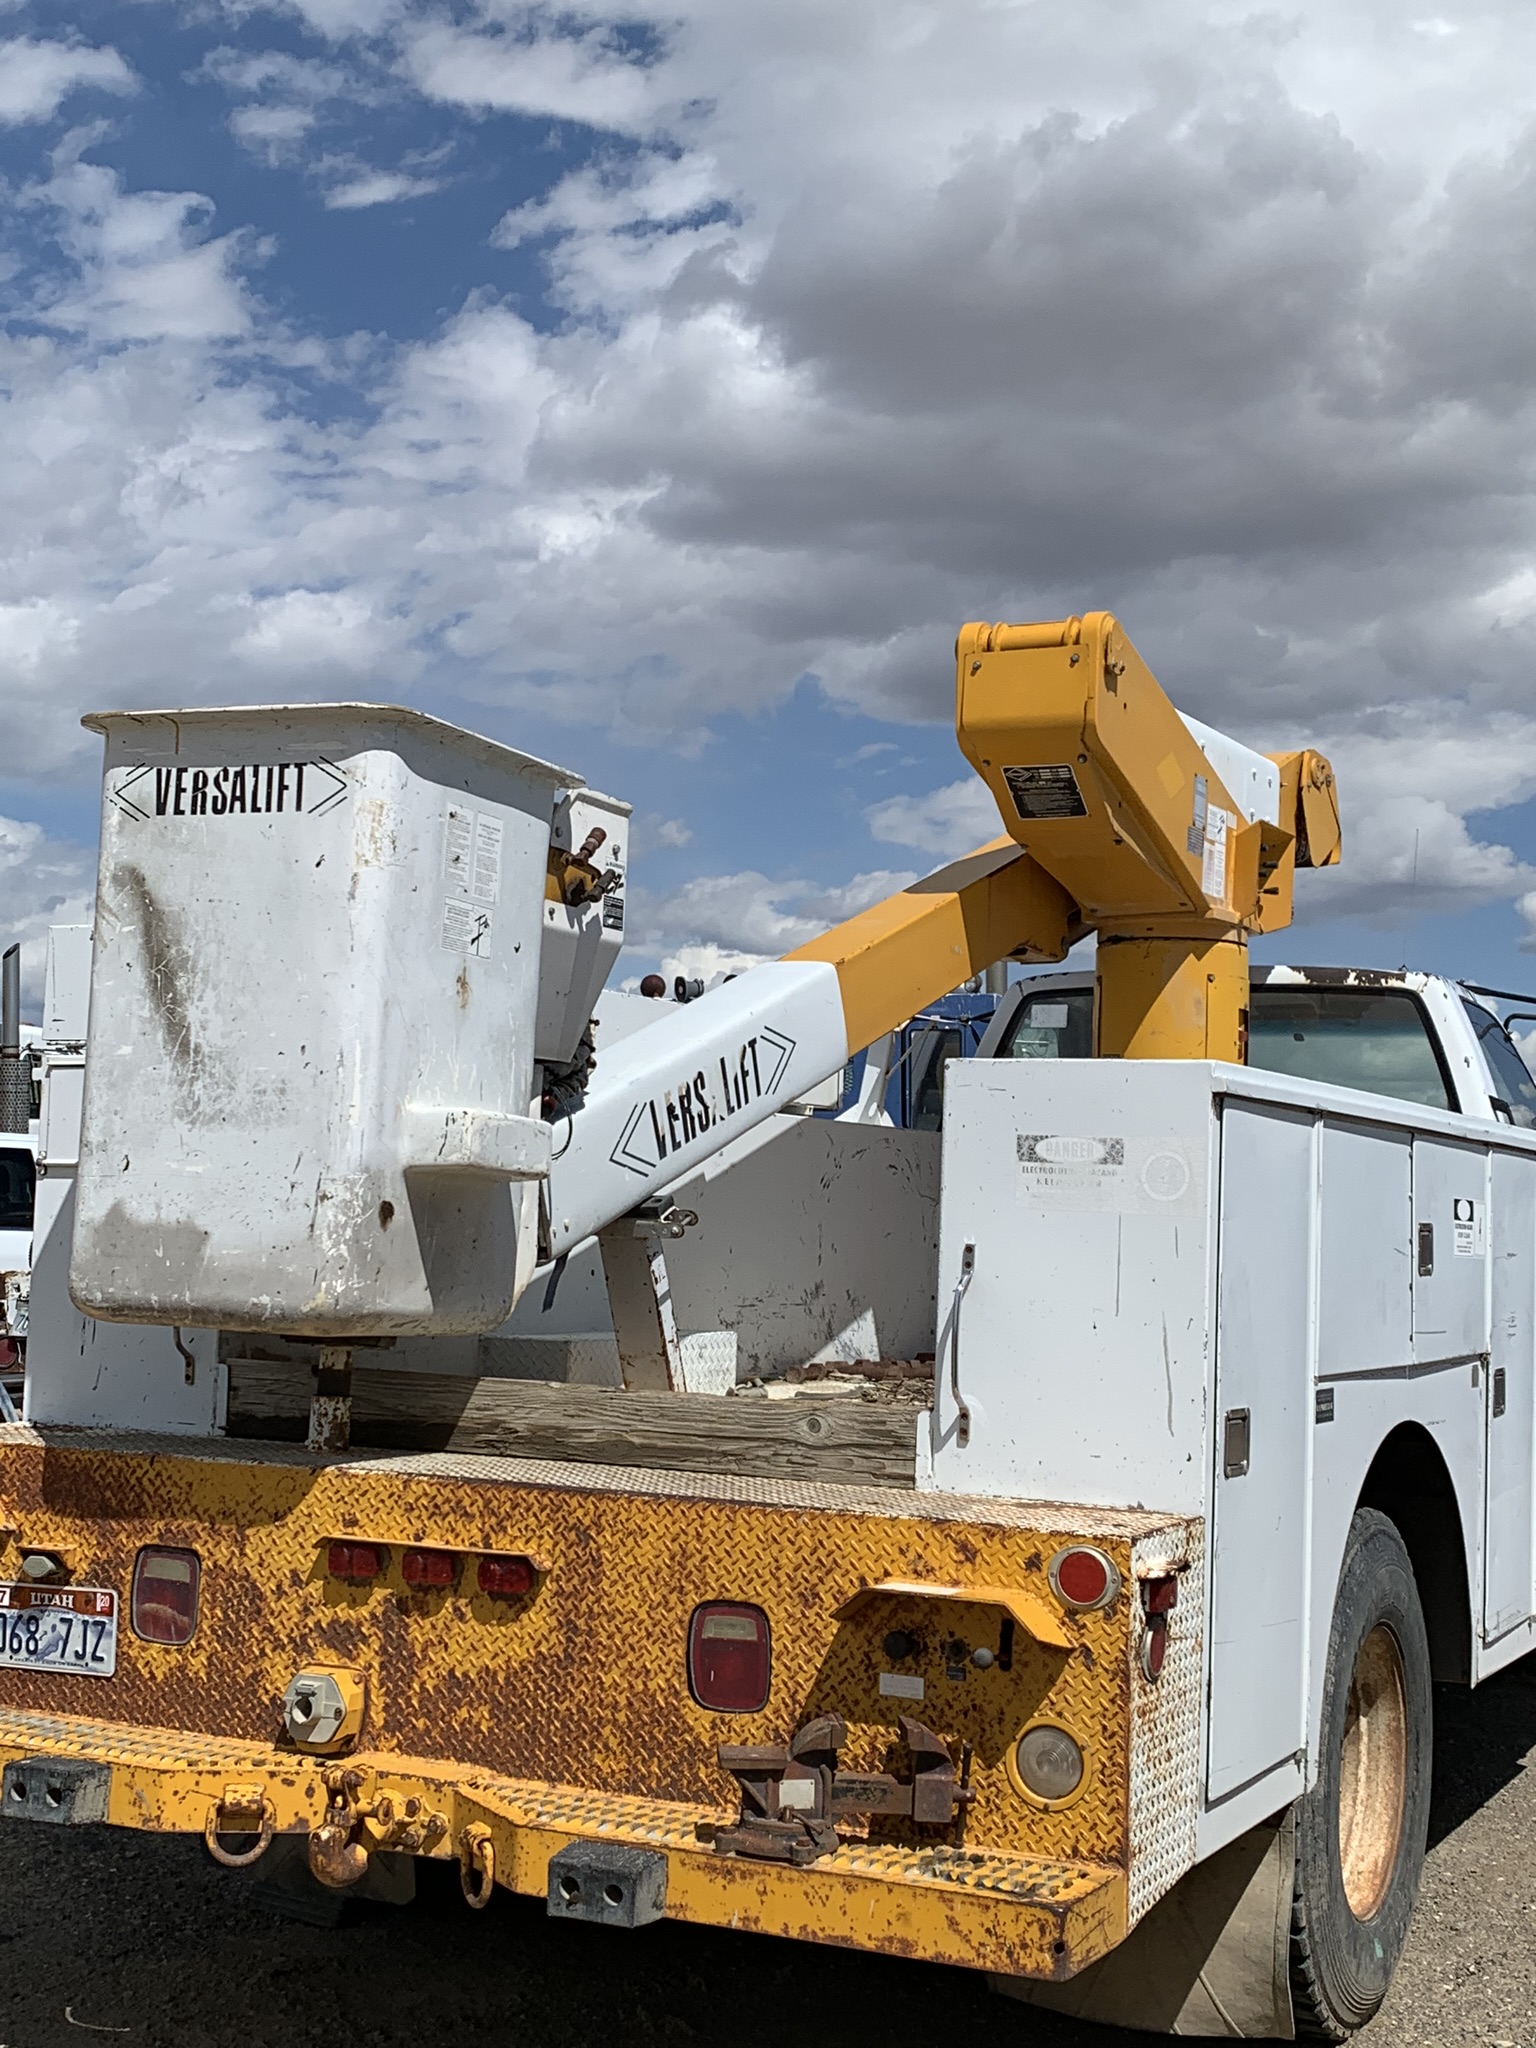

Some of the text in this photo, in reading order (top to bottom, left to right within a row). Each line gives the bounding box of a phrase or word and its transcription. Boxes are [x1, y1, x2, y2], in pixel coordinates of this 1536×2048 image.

[156, 761, 308, 816] VERSALIFT
[1045, 1140, 1094, 1159] DANGER
[30, 1592, 74, 1608] UTAH
[101, 1595, 110, 1606] 20
[59, 1617, 107, 1661] 7JZ
